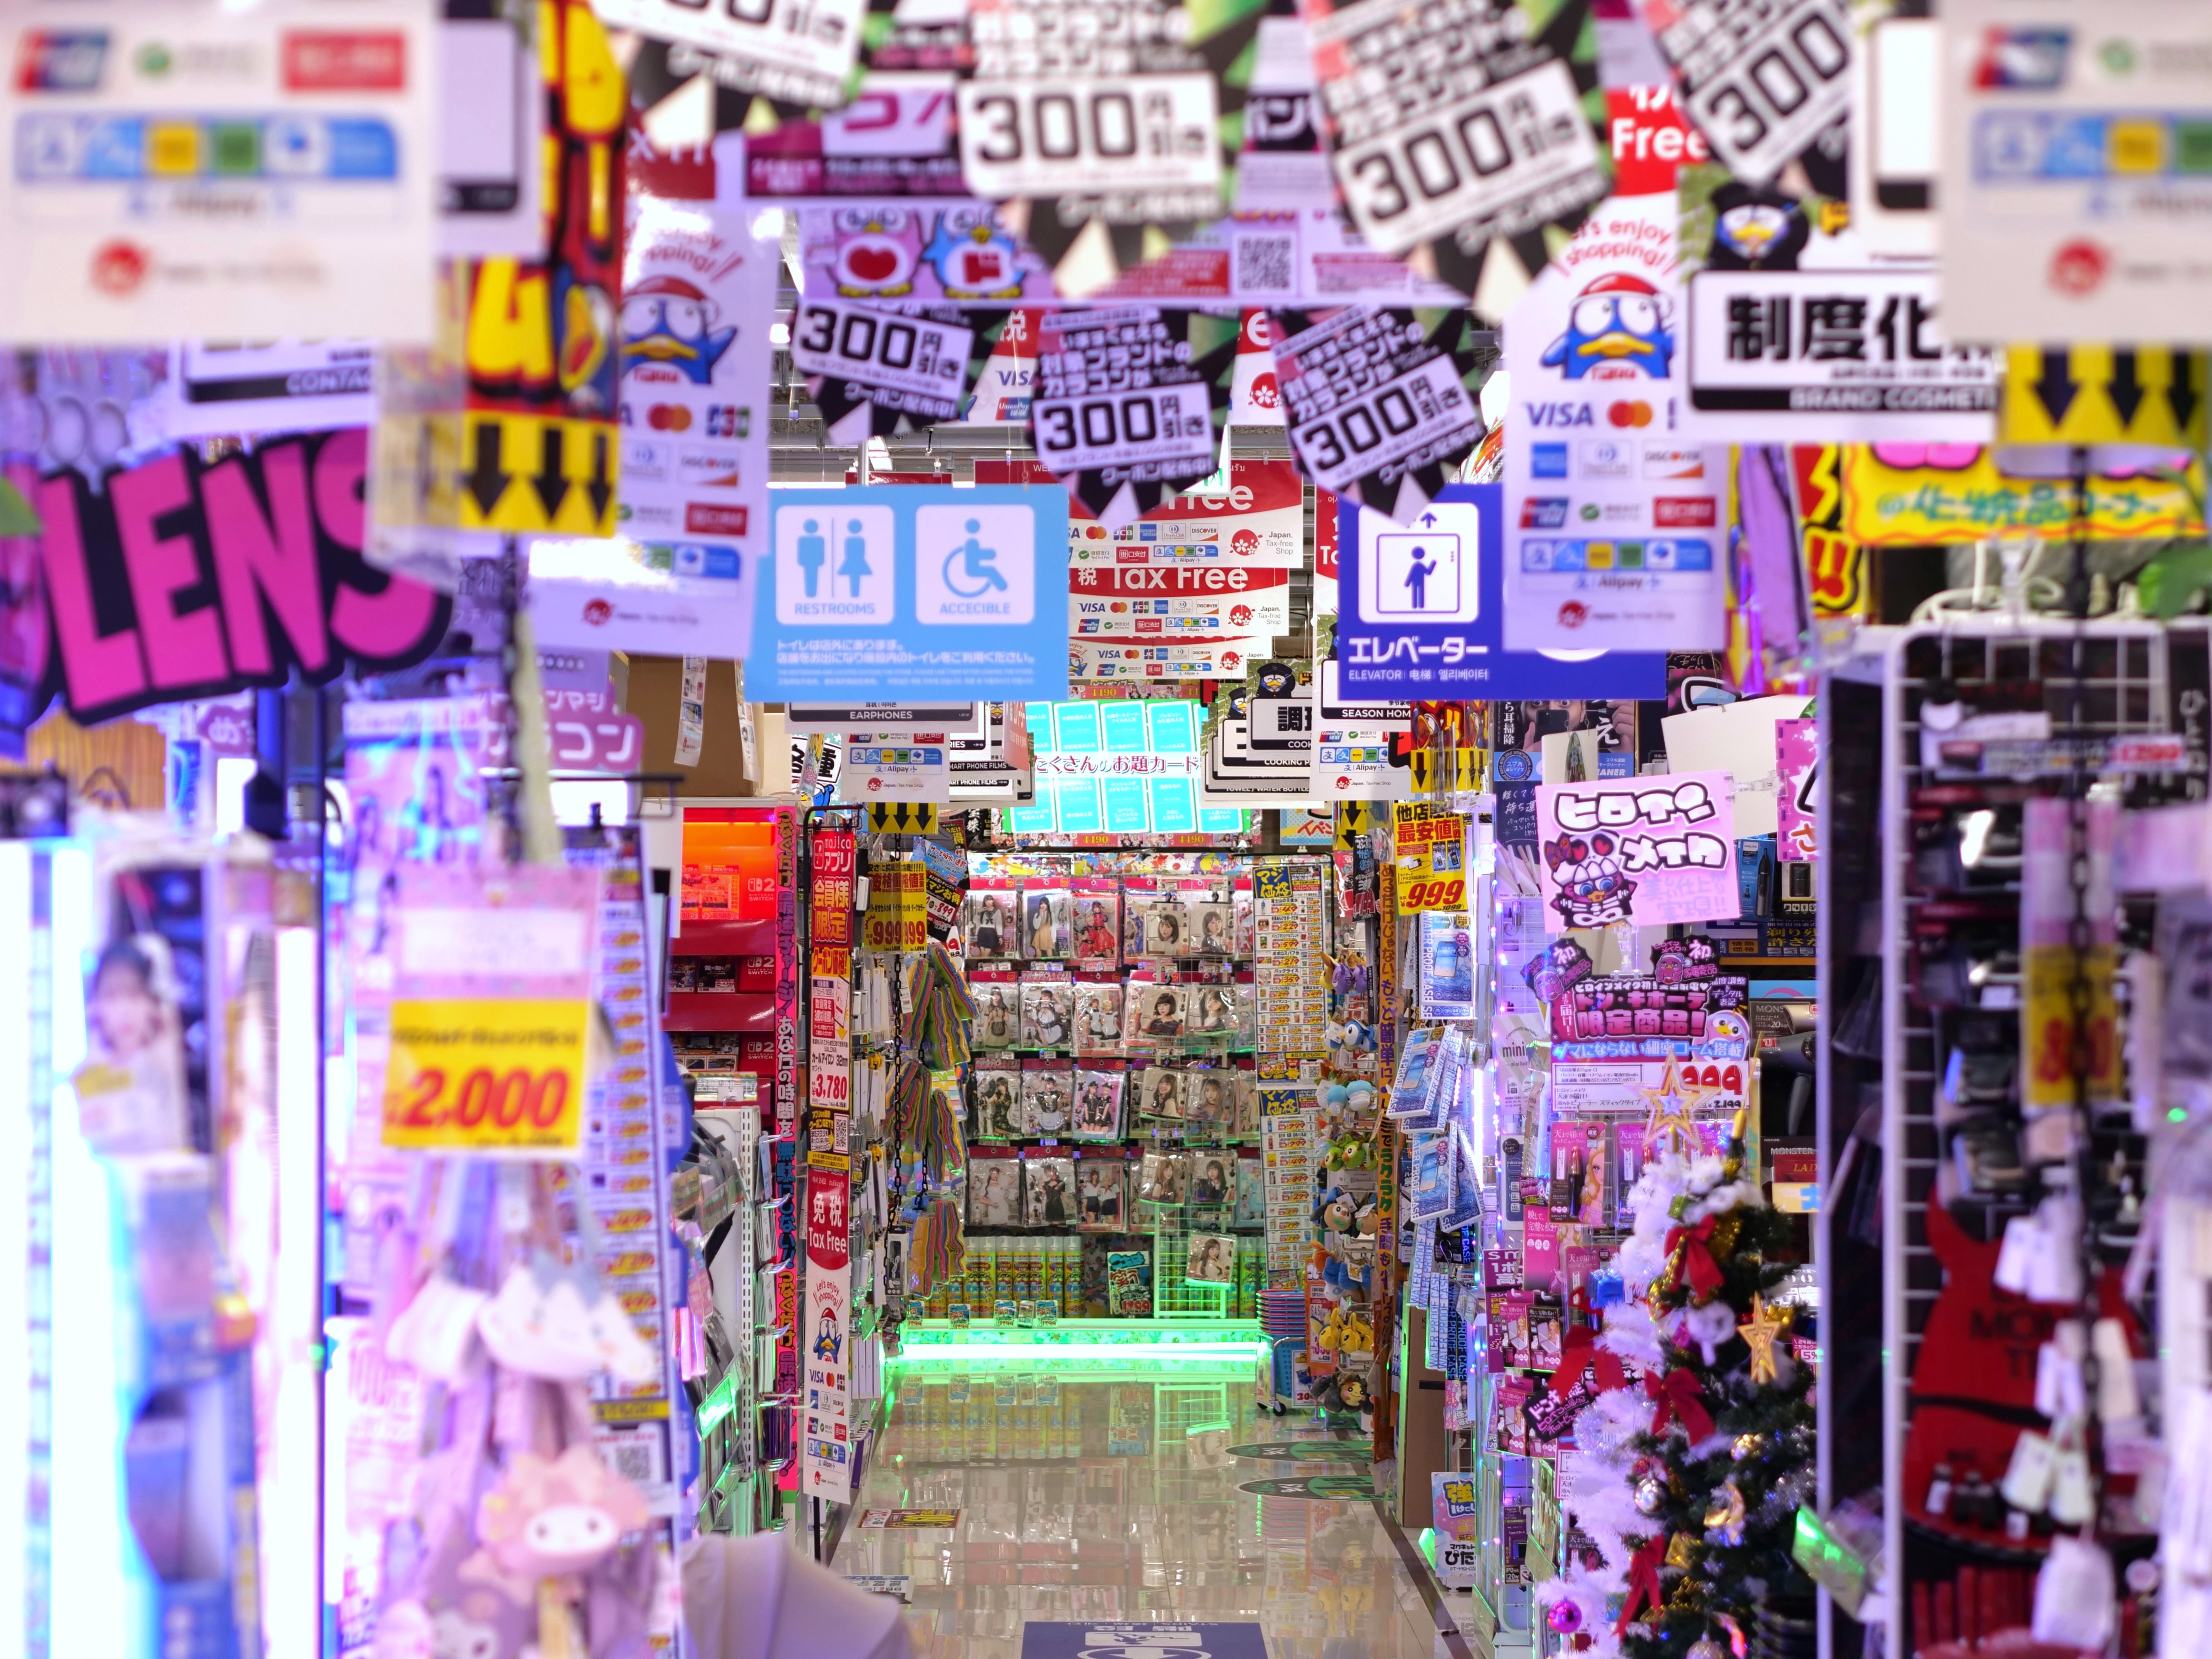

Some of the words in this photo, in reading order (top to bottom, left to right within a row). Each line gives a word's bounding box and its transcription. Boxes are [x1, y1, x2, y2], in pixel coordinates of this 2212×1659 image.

[1791, 388, 1878, 410] BRAND
[1525, 402, 1594, 427] VISA
[1266, 540, 1294, 548] Tax-free
[1276, 547, 1294, 555] Shop
[40, 426, 436, 711] LENS
[794, 603, 875, 614] RESTROOMS
[940, 602, 1010, 614] ACCECIBLE
[1078, 603, 1106, 612] VISA
[1096, 650, 1121, 658] VISA
[1349, 637, 1488, 664] エレベーター
[1349, 669, 1401, 680] ELEVATOR
[1409, 669, 1431, 681] 电梯
[1438, 668, 1488, 681] 엘리베이터
[1090, 688, 1117, 696] 4490
[850, 711, 913, 720] EARPHONES
[1342, 709, 1384, 718] SEASON
[887, 765, 909, 774] Alipay
[1397, 819, 1453, 843] 最安値
[1452, 818, 1461, 839] 挑戦
[1082, 835, 1109, 844] 4490
[1178, 835, 1204, 844] 4490
[824, 851, 851, 872] アプリ
[764, 878, 775, 892] 2
[814, 879, 850, 908] 会員様
[1260, 881, 1291, 898] 価格
[816, 911, 847, 939] 限定
[872, 921, 901, 945] 999
[1553, 946, 1577, 965] 初
[1689, 939, 1712, 959] 初
[763, 956, 774, 968] 2
[1575, 991, 1708, 1011] ドン・キホーテ
[1719, 998, 1737, 1007] 表記
[1577, 1010, 1707, 1036] 限定商品!
[811, 1051, 835, 1066] カールアイロン
[777, 1015, 795, 1138] あなたの時間を
[813, 1191, 842, 1228] 免税
[808, 1227, 825, 1250] Tax
[826, 1230, 847, 1254] Free
[827, 1280, 840, 1296] enjoy
[1431, 1273, 1440, 1298] CASE
[1439, 1275, 1448, 1298] CASE
[1430, 1303, 1439, 1335] PROOF
[1439, 1303, 1448, 1335] PROOF
[1447, 1321, 1456, 1352] PROOF
[1458, 1321, 1467, 1352] PROOF
[1429, 1339, 1438, 1368] WATER
[1438, 1339, 1447, 1369] WATER
[808, 1369, 824, 1385] VISA
[1447, 1354, 1456, 1380] CASE
[1458, 1354, 1467, 1381] CASE
